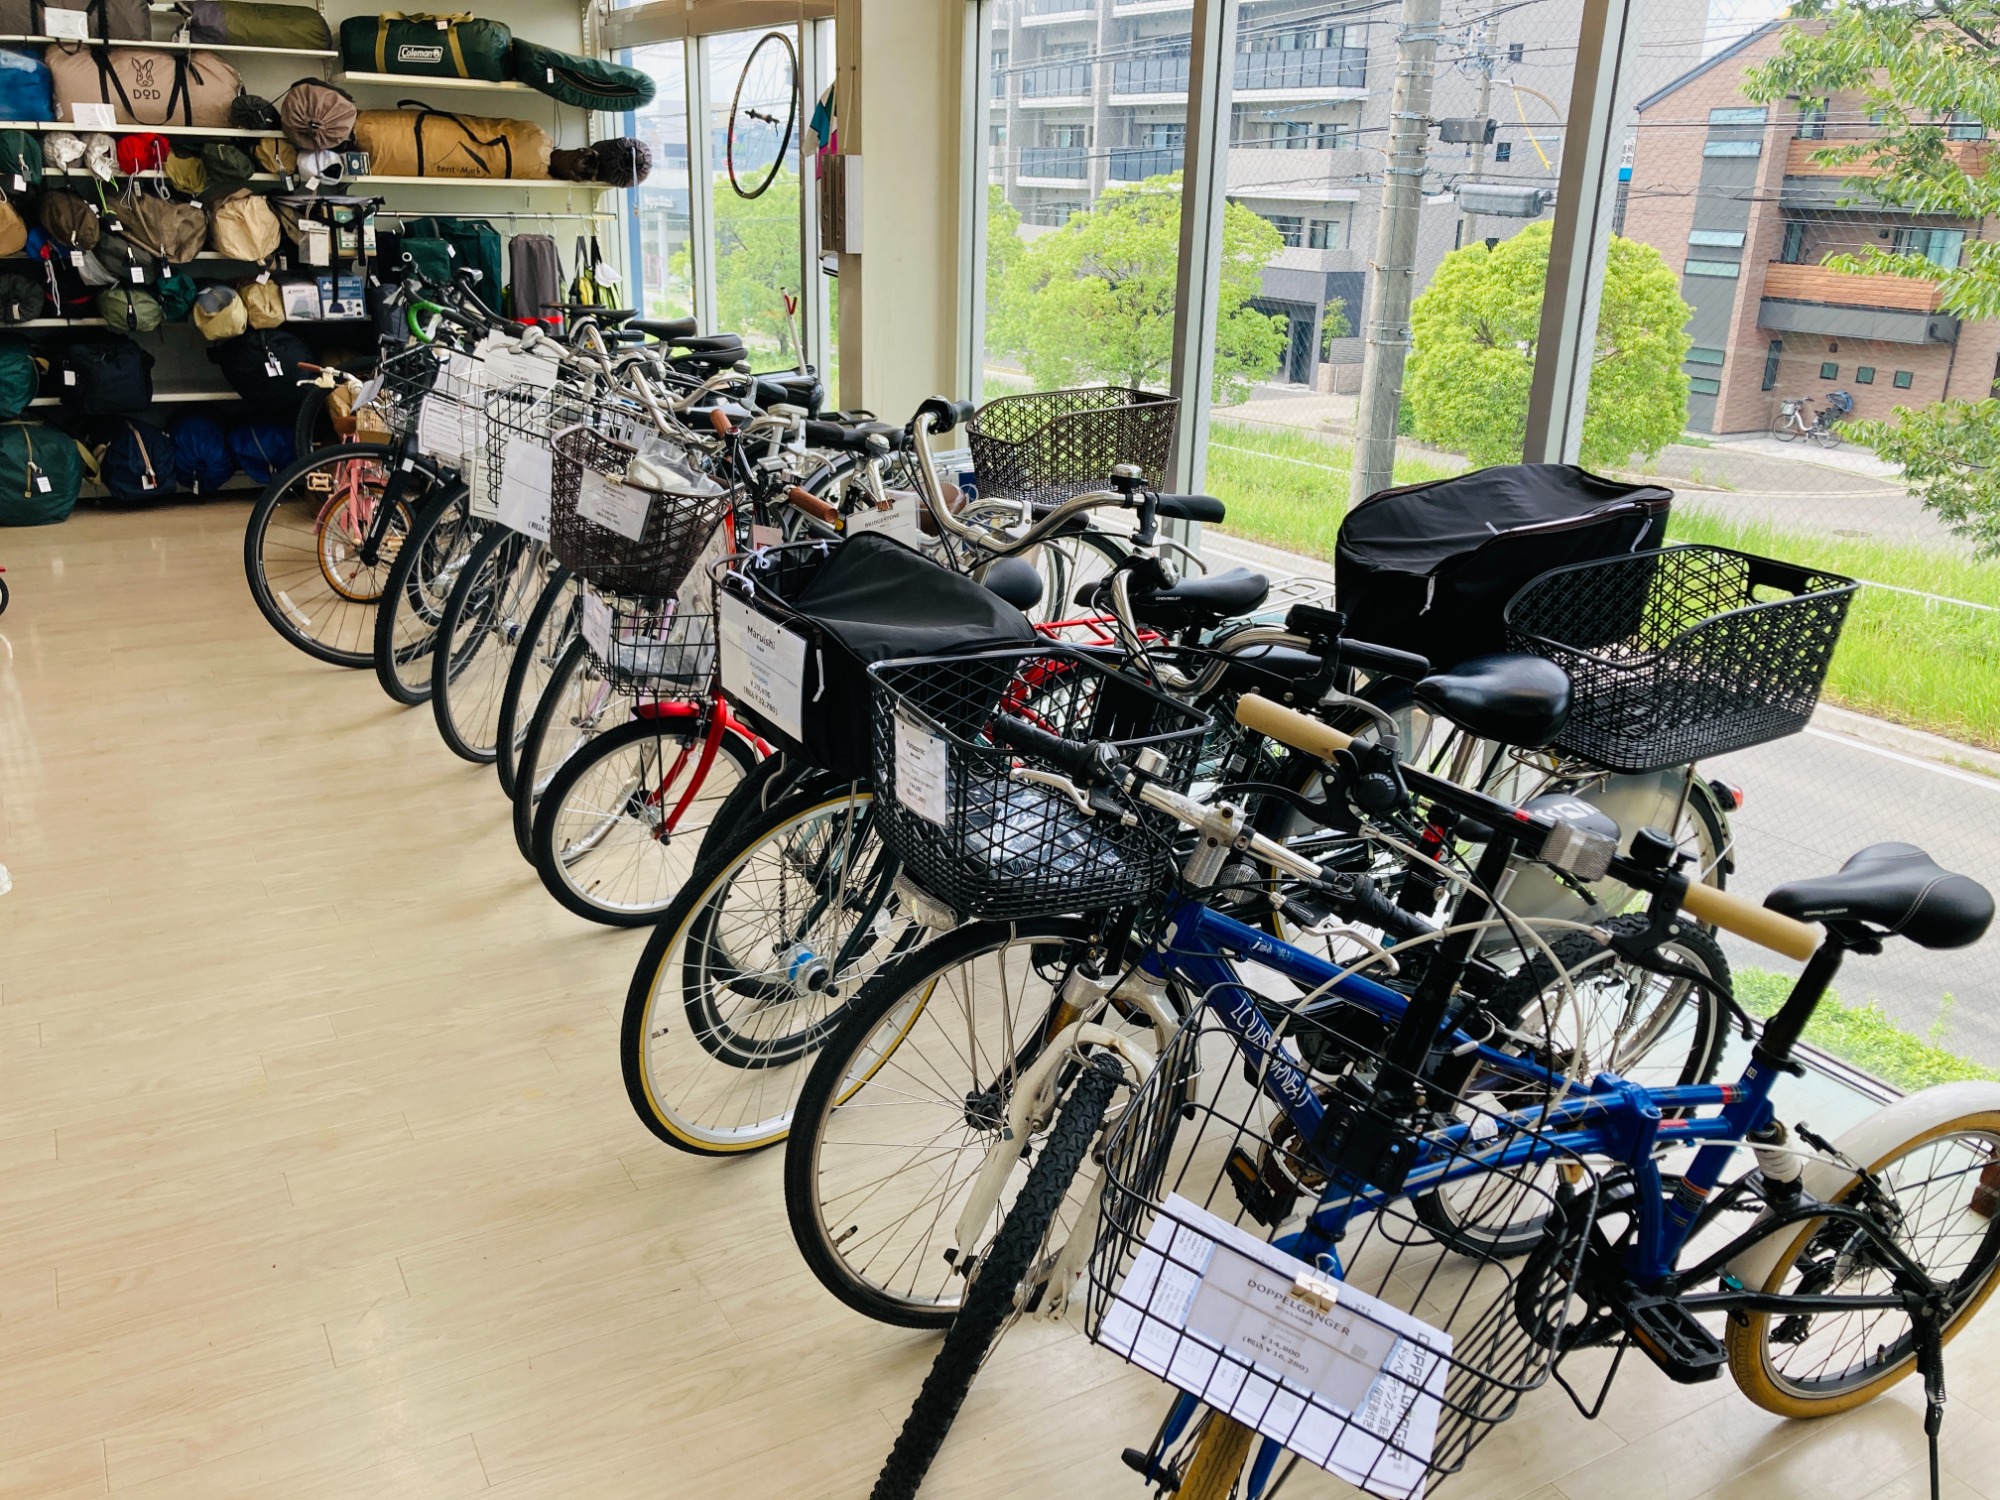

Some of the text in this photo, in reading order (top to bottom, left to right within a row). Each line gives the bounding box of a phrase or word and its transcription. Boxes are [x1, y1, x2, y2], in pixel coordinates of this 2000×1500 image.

[401, 47, 433, 58] Coleman
[864, 511, 901, 529] BRIDGESTONE
[747, 624, 777, 650] Maruishi
[1247, 1279, 1351, 1337] DOPPELGANGER
